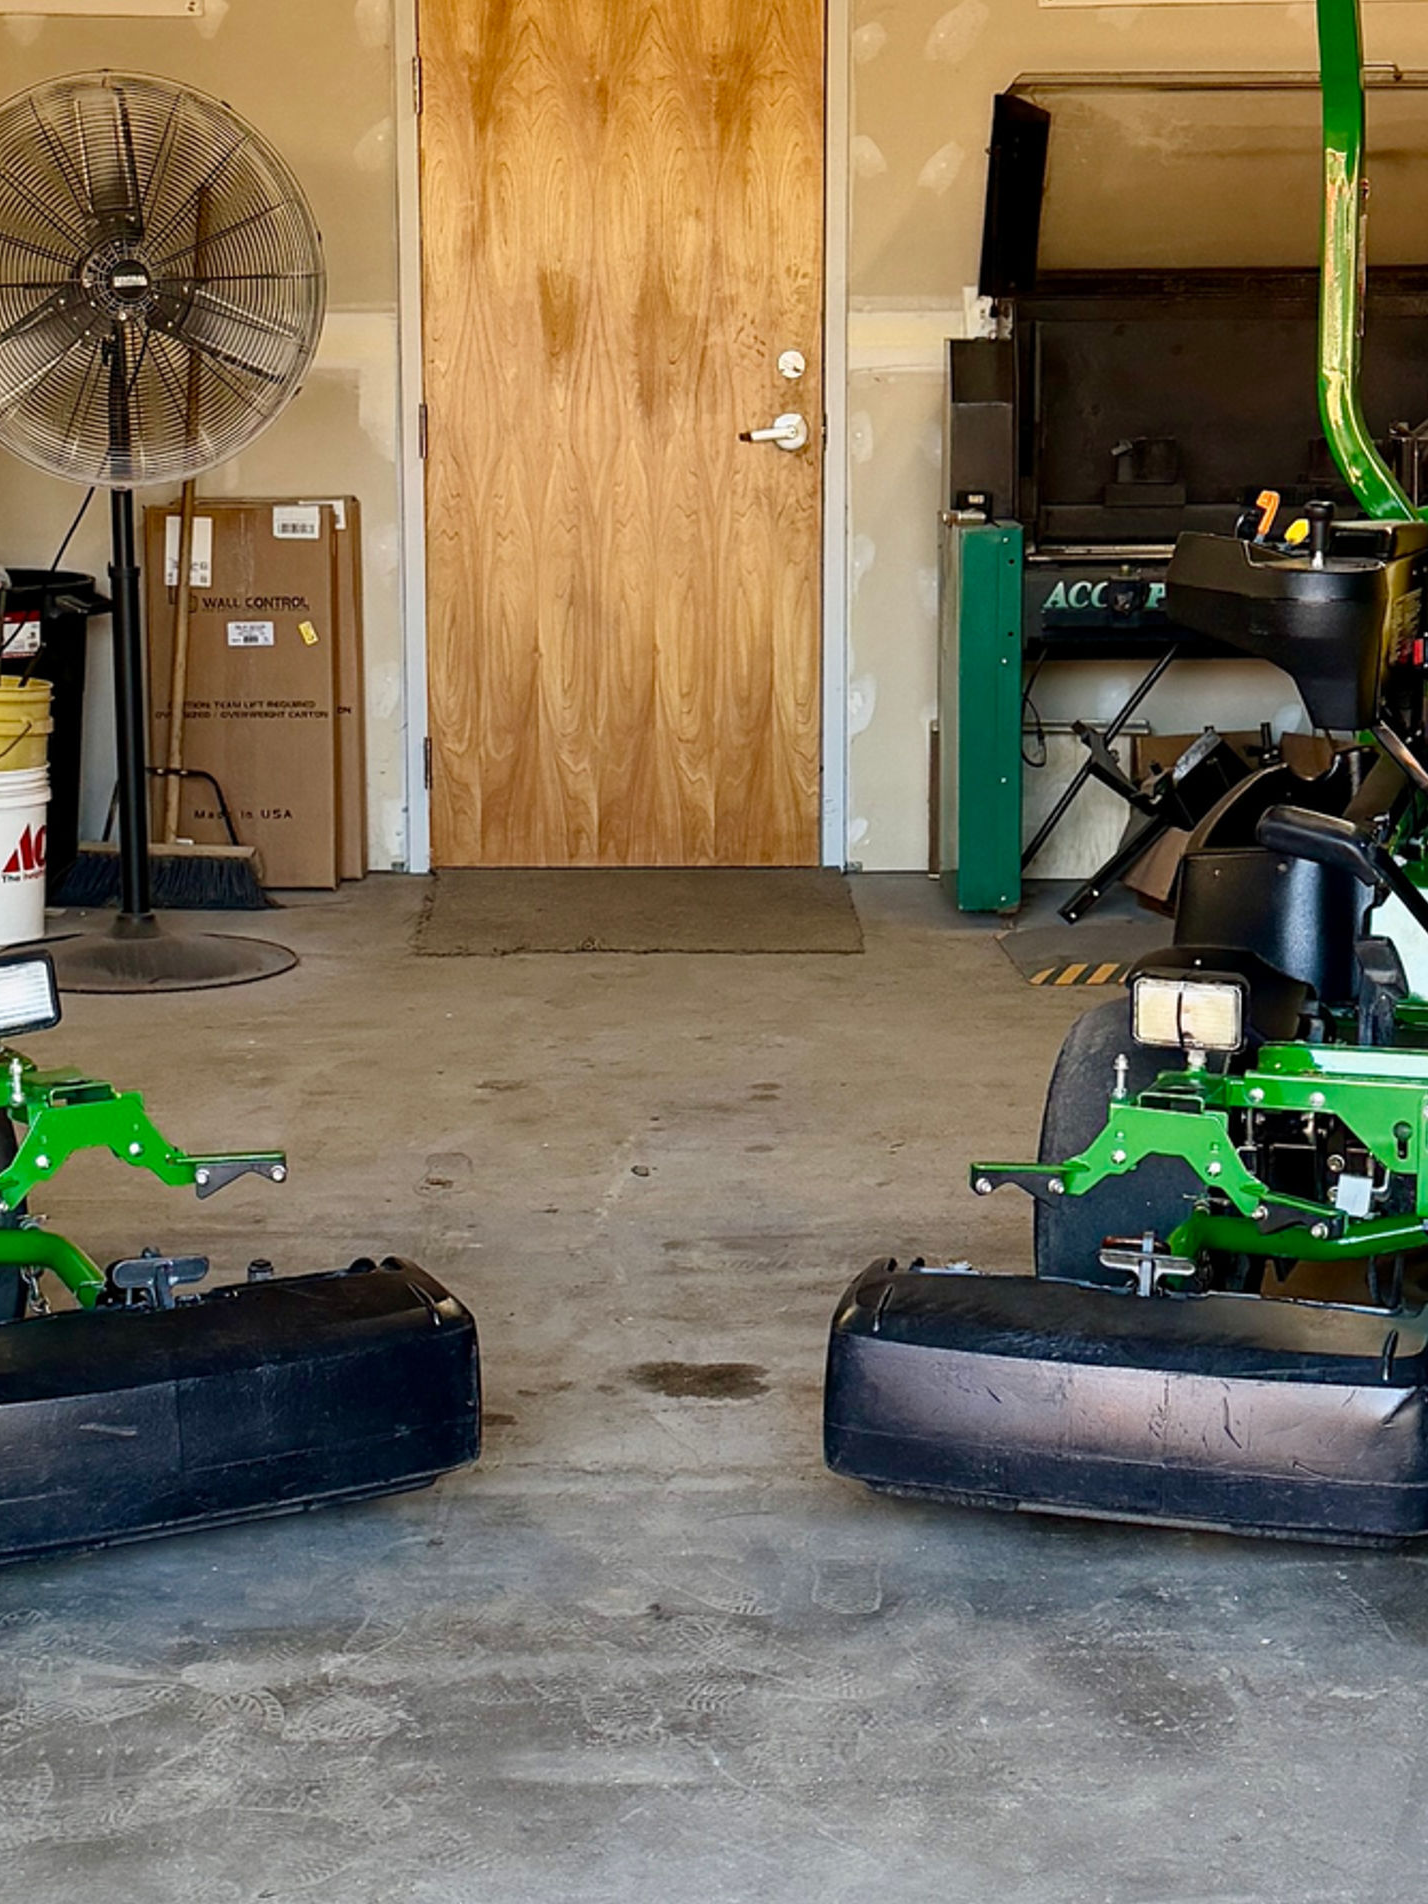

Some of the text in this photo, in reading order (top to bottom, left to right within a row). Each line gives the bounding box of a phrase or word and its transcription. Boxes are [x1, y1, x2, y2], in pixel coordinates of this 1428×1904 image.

[201, 596, 311, 612] WALL CONTROL
[259, 807, 293, 820] USA
[2, 822, 47, 873] AC
